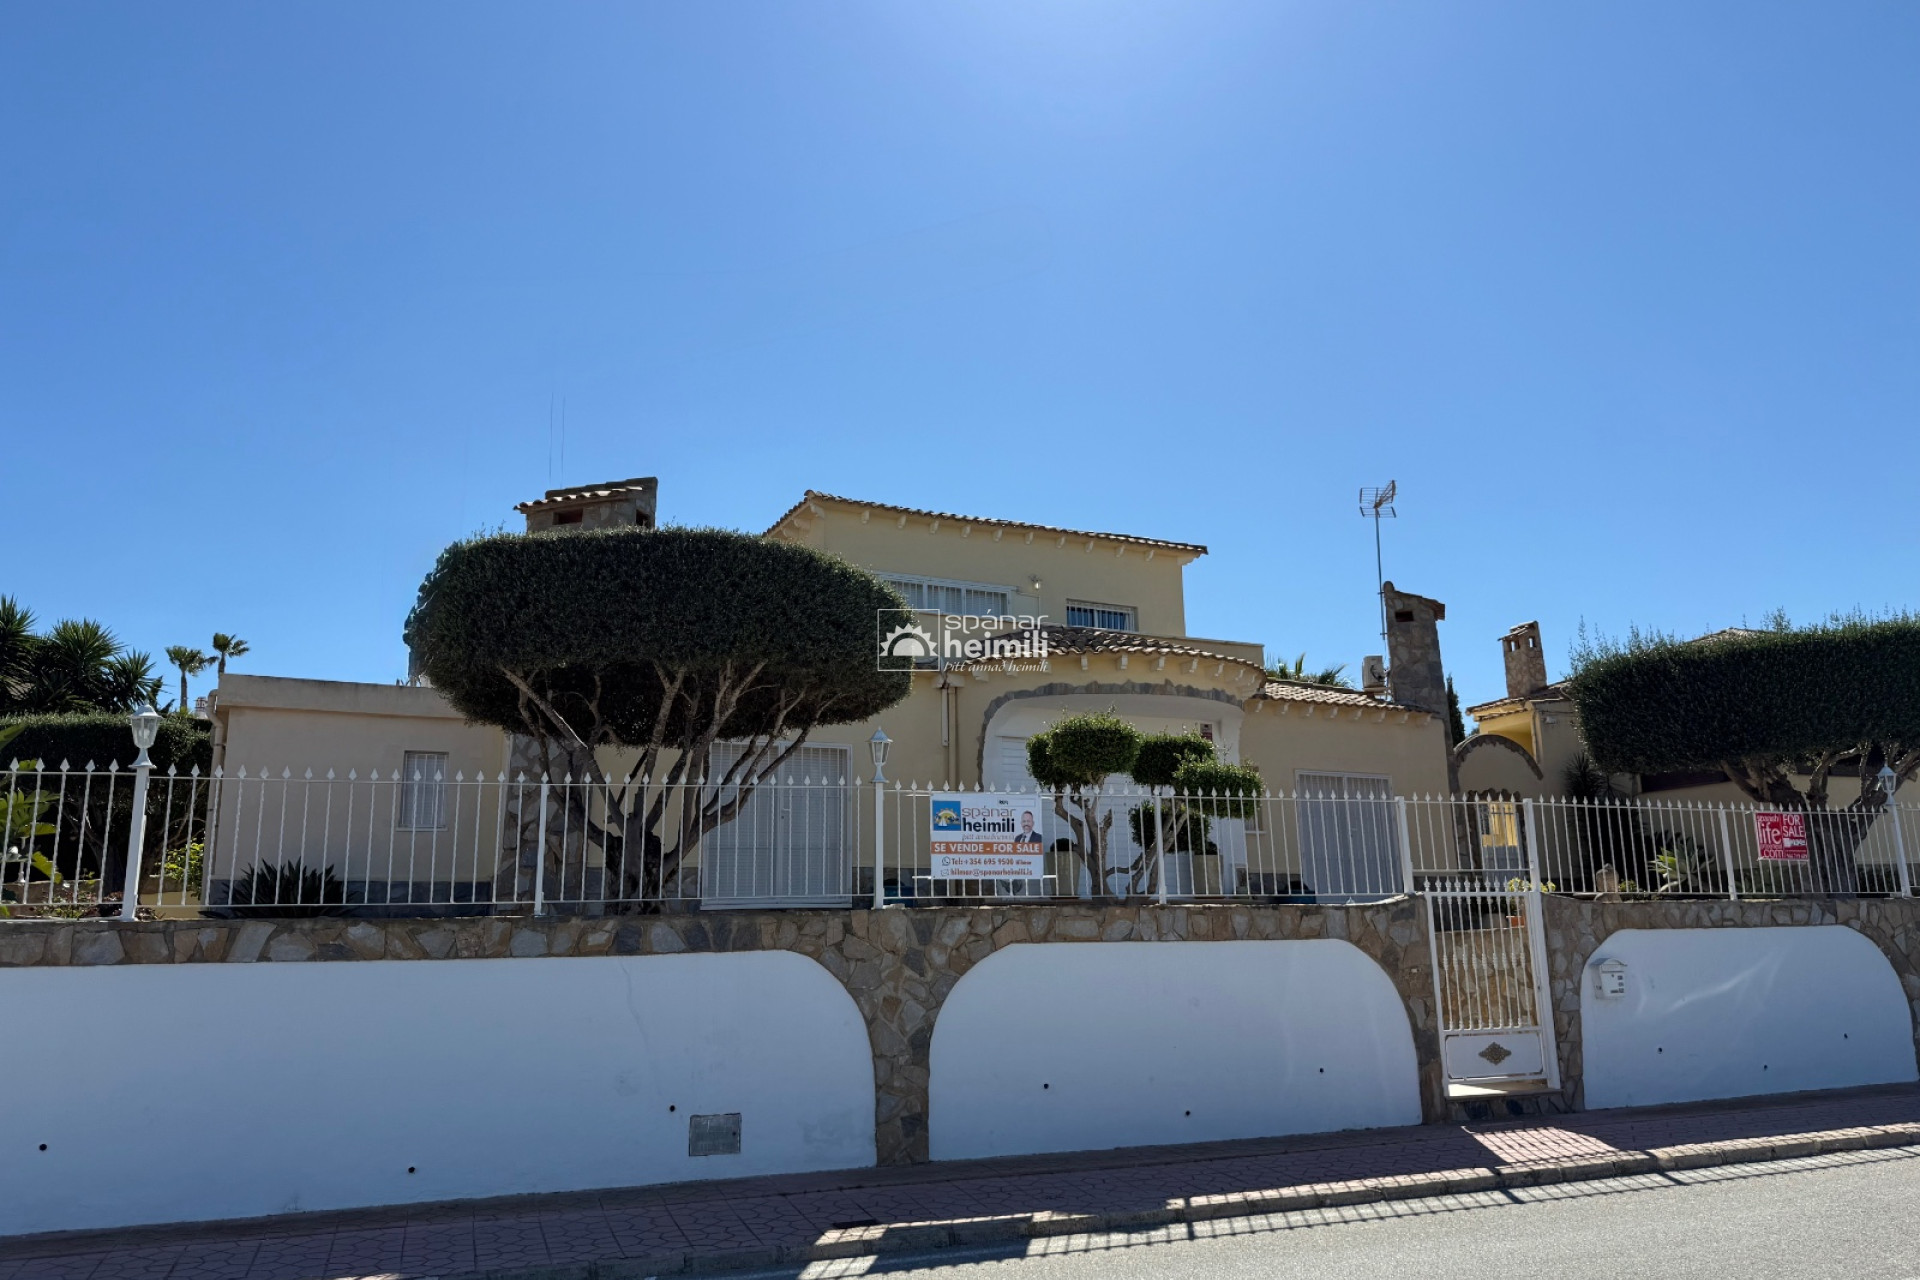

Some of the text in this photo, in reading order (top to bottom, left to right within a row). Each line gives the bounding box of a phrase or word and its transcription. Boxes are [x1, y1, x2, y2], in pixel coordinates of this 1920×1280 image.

[962, 805, 1016, 819] spánar
[963, 818, 1015, 833] heimili
[1782, 814, 1801, 826] FOR
[1757, 820, 1782, 845] life
[1782, 825, 1805, 838] SALE
[934, 843, 947, 853] SE
[949, 843, 984, 853] VENDE
[993, 843, 1014, 853] FOR
[1016, 843, 1040, 853] SALE
